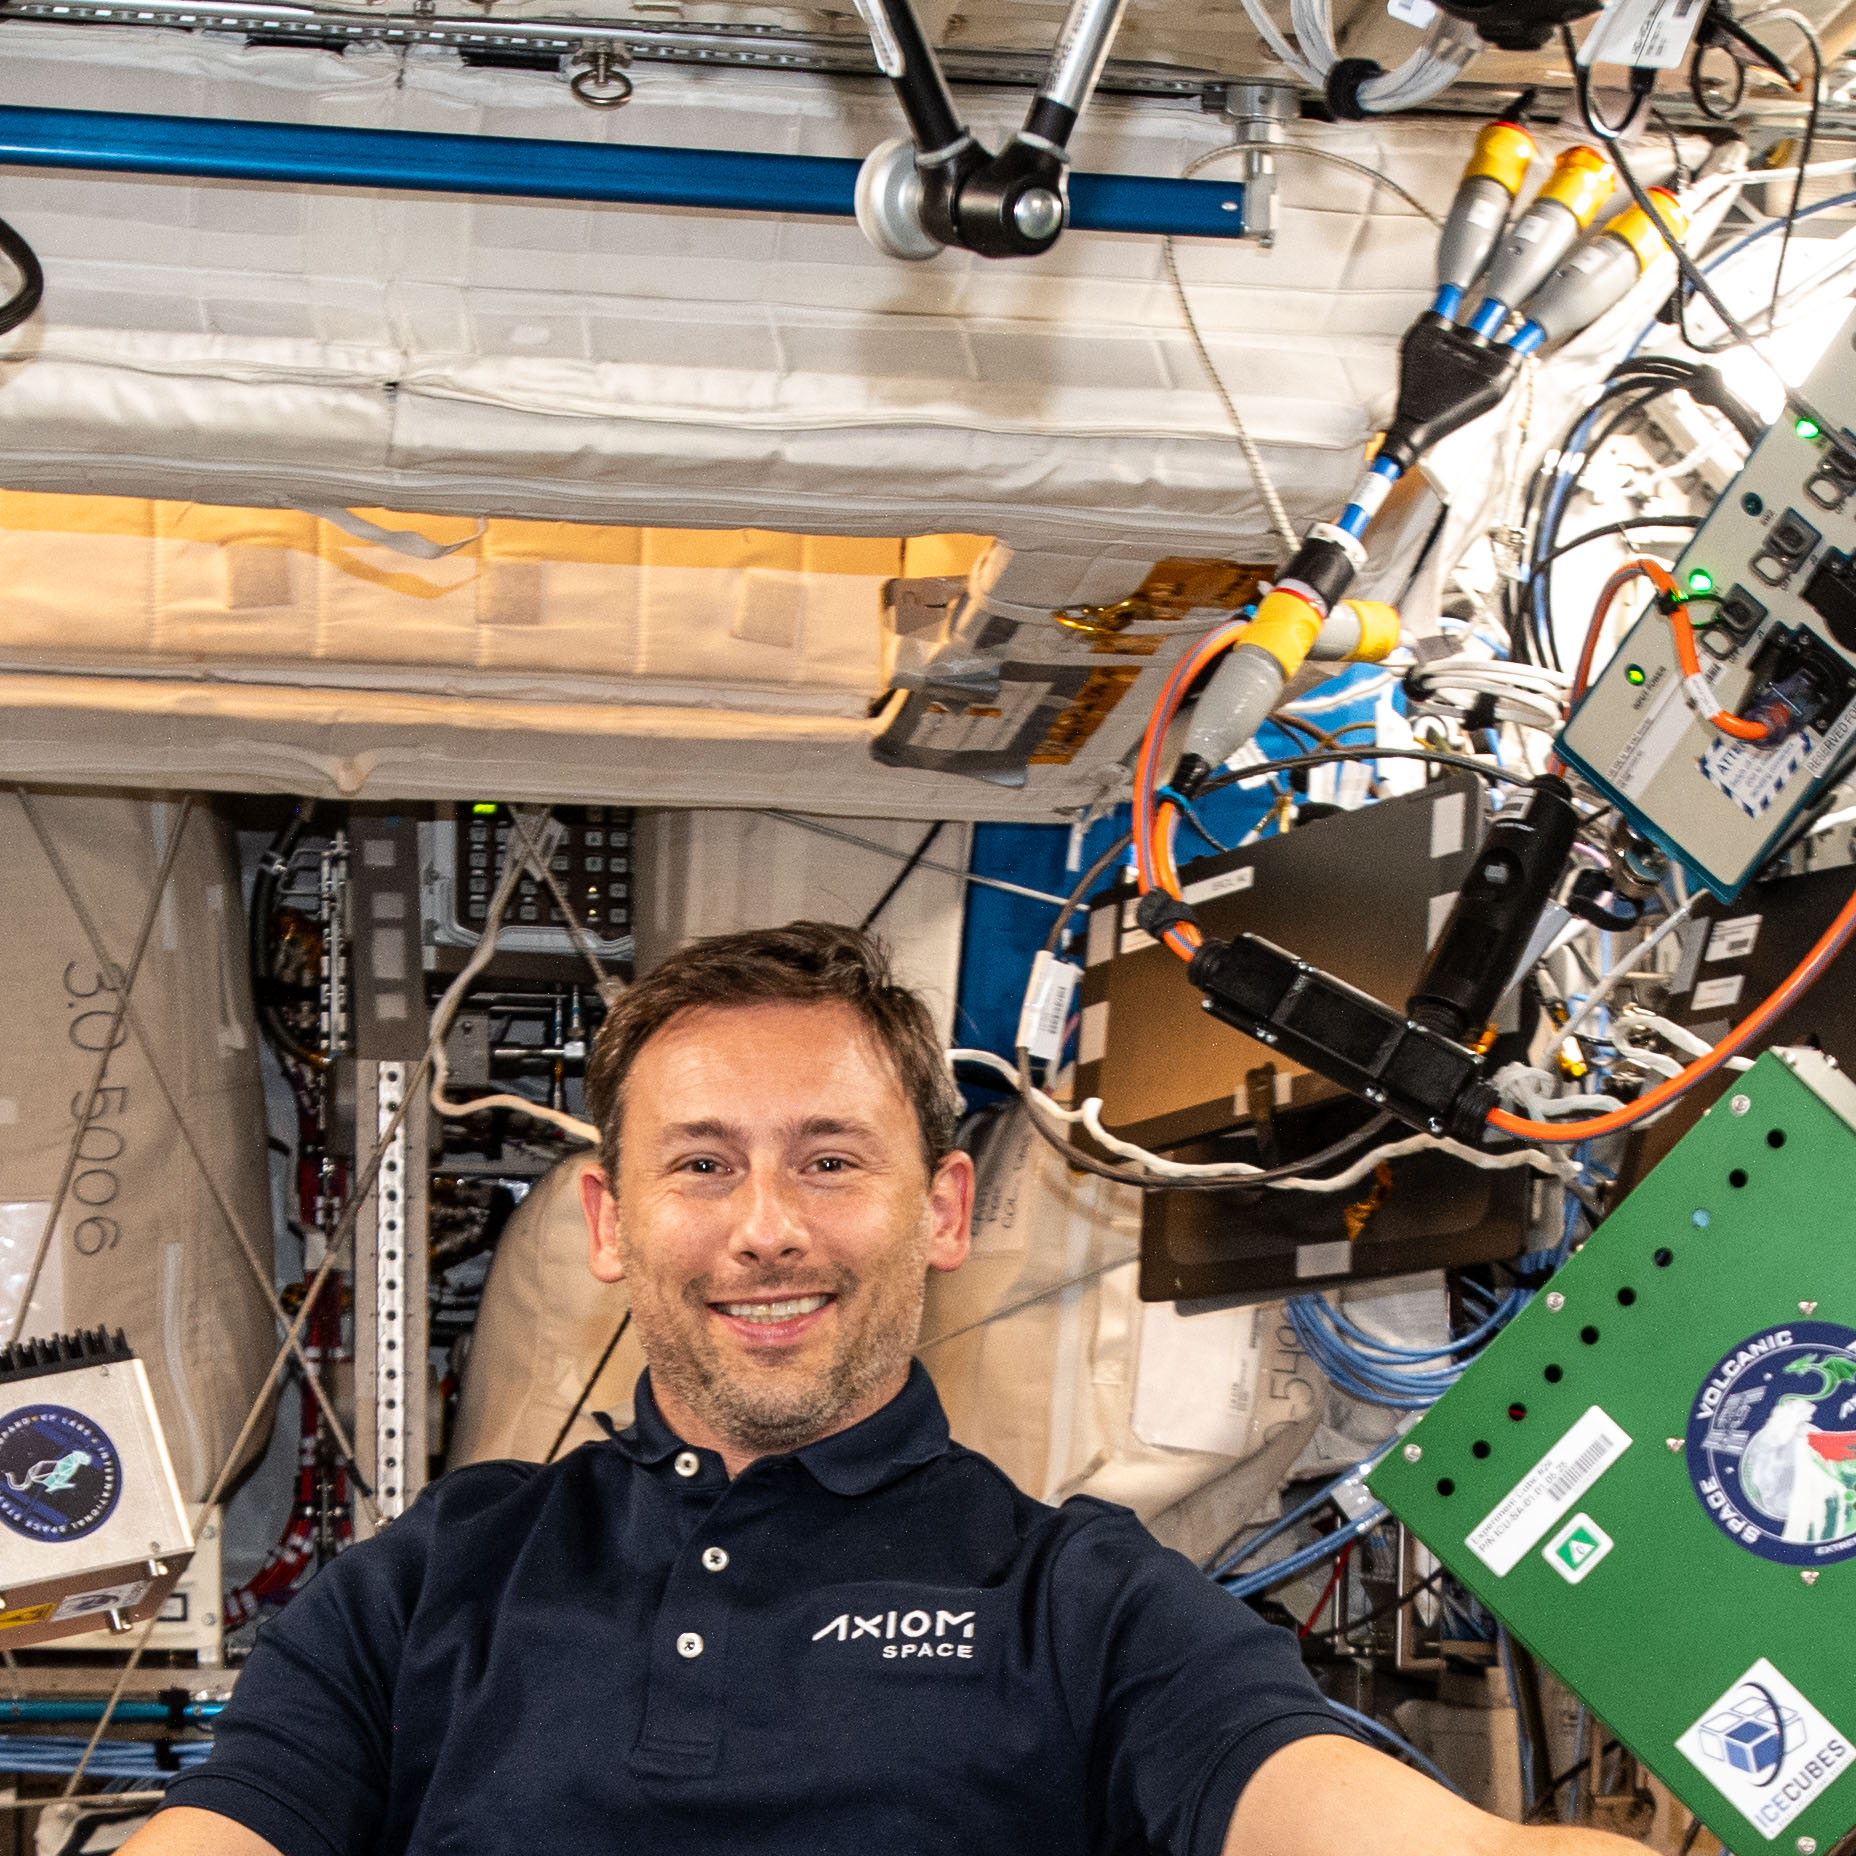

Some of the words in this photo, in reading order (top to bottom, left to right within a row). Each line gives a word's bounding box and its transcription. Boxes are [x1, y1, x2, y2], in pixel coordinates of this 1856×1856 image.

[1629, 688, 1651, 711] INPUT
[1642, 664, 1670, 692] POWER
[1803, 721, 1850, 774] RESERVED
[1694, 1329, 1797, 1423] VOLCANIC
[60, 1416, 94, 1437] LABS
[69, 1445, 116, 1529] INTERNATIONAL
[1699, 1475, 1762, 1545] SPACE
[23, 1518, 68, 1535] SPACE
[812, 1610, 976, 1642] AXIOM
[882, 1643, 974, 1660] SPACE
[1753, 1733, 1848, 1833] ICECUBES
